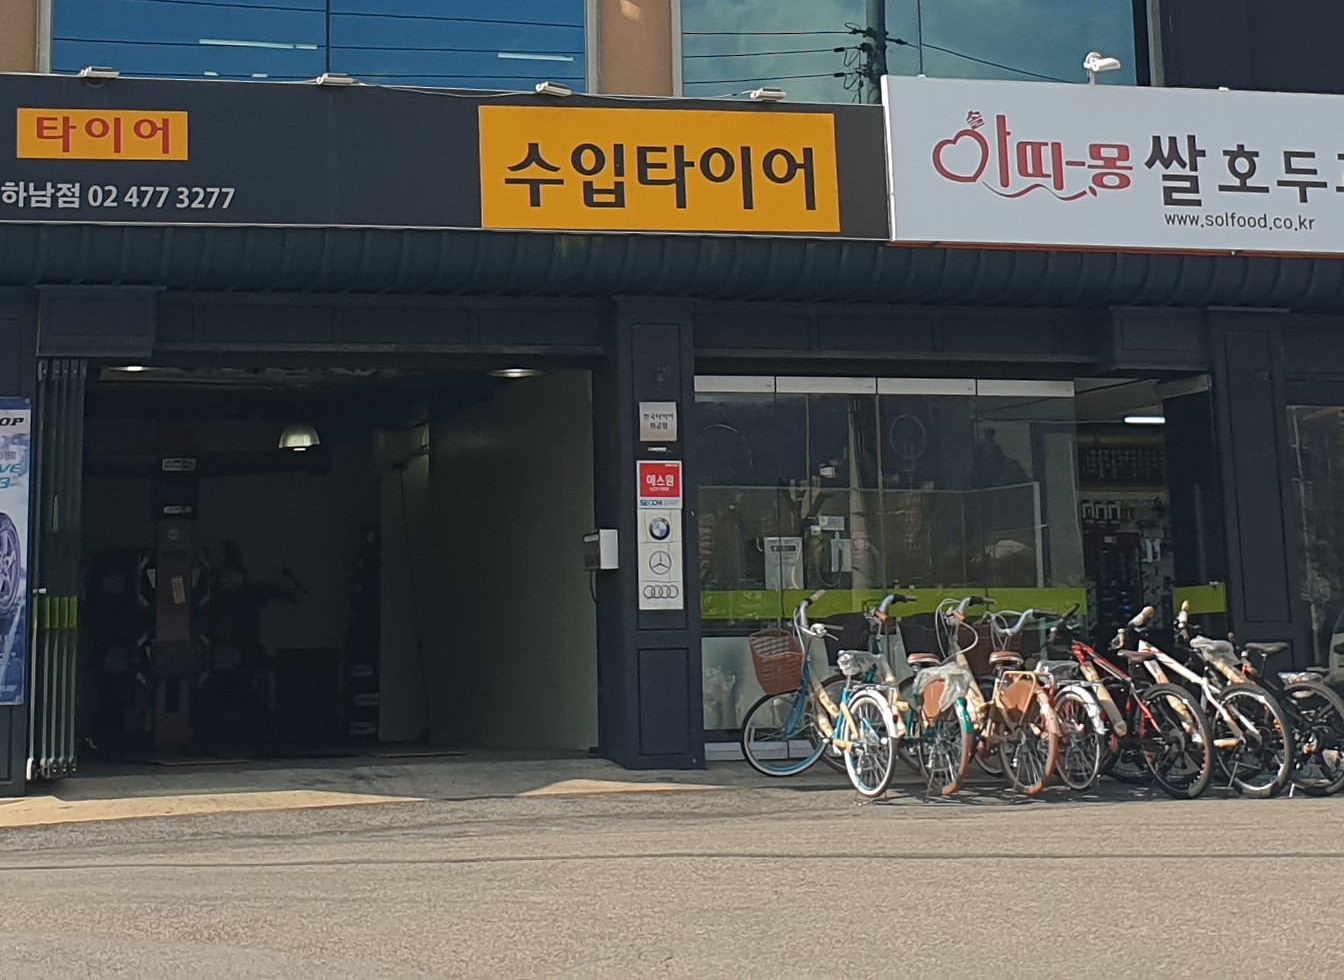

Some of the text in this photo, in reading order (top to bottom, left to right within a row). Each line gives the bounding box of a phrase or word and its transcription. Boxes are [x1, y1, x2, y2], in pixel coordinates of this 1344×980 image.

[35, 114, 173, 156] 타이어
[503, 141, 818, 213] 수입타이어
[88, 183, 118, 209] 02
[123, 184, 171, 210] 477
[175, 185, 236, 212] 3277
[1163, 209, 1317, 234] www.solfood.co.kr
